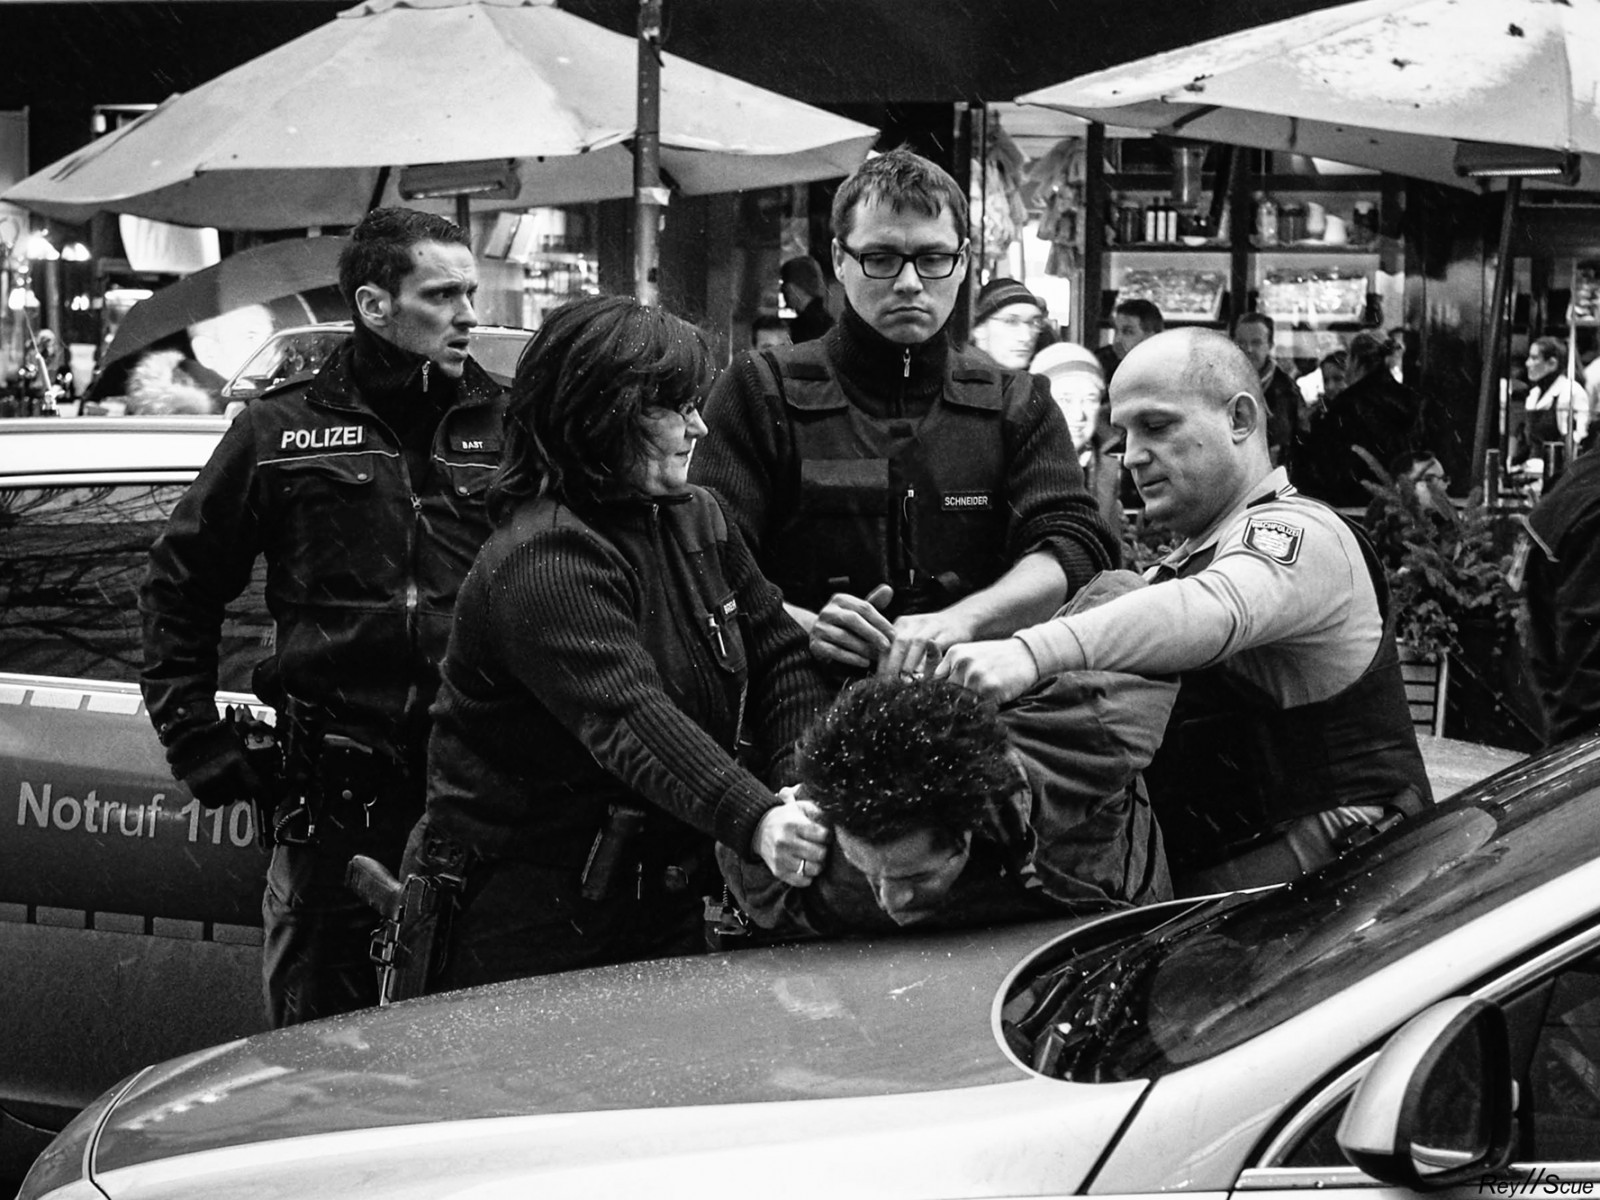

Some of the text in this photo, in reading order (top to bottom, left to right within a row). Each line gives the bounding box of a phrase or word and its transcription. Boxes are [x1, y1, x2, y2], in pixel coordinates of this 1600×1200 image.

[281, 425, 364, 449] POLIZEI
[461, 440, 484, 450] BAST
[944, 495, 989, 506] SCHNEIDER
[17, 781, 255, 848] Notruf 110
